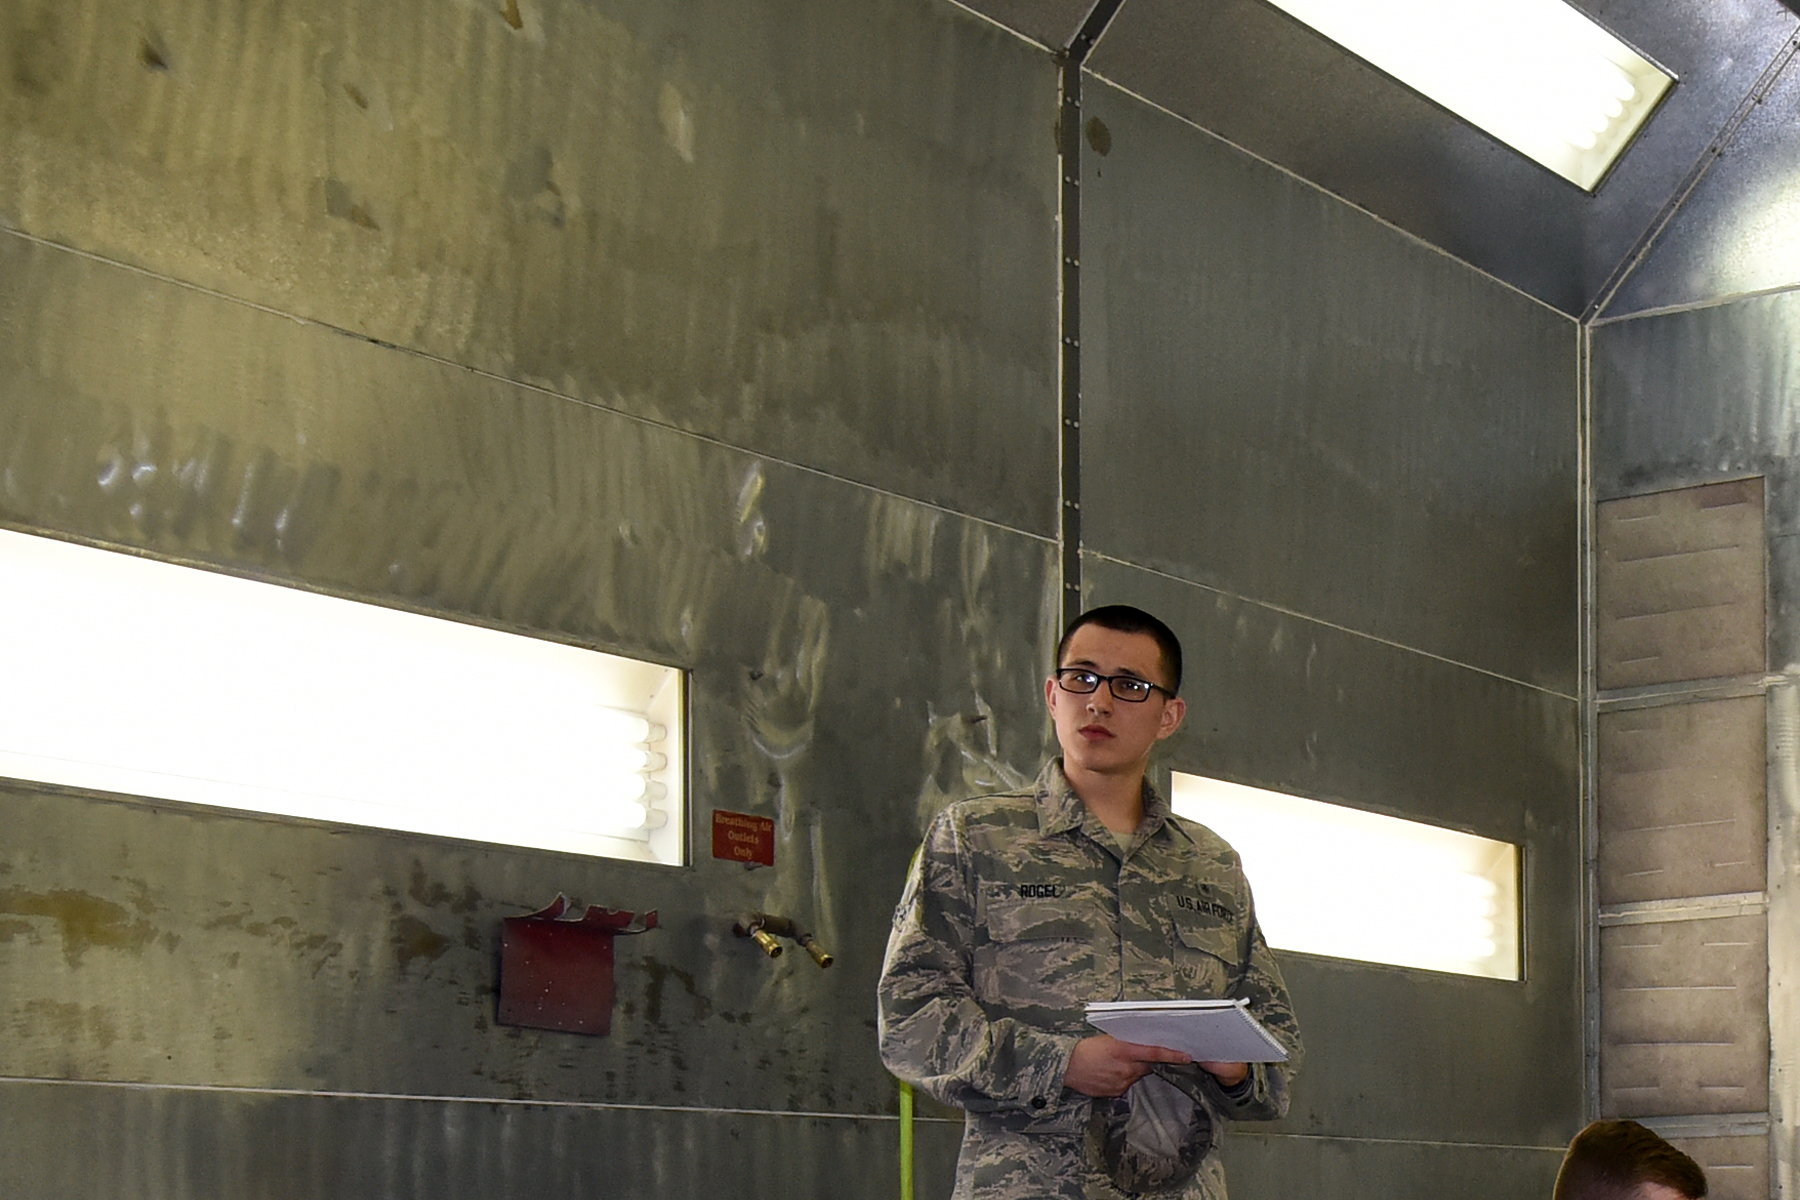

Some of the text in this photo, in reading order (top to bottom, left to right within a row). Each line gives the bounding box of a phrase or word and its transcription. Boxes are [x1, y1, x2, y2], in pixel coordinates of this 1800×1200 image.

[715, 813, 758, 832] Breathing
[728, 830, 759, 845] Outlets
[734, 846, 752, 860] Only
[1020, 884, 1061, 898] ROGEL
